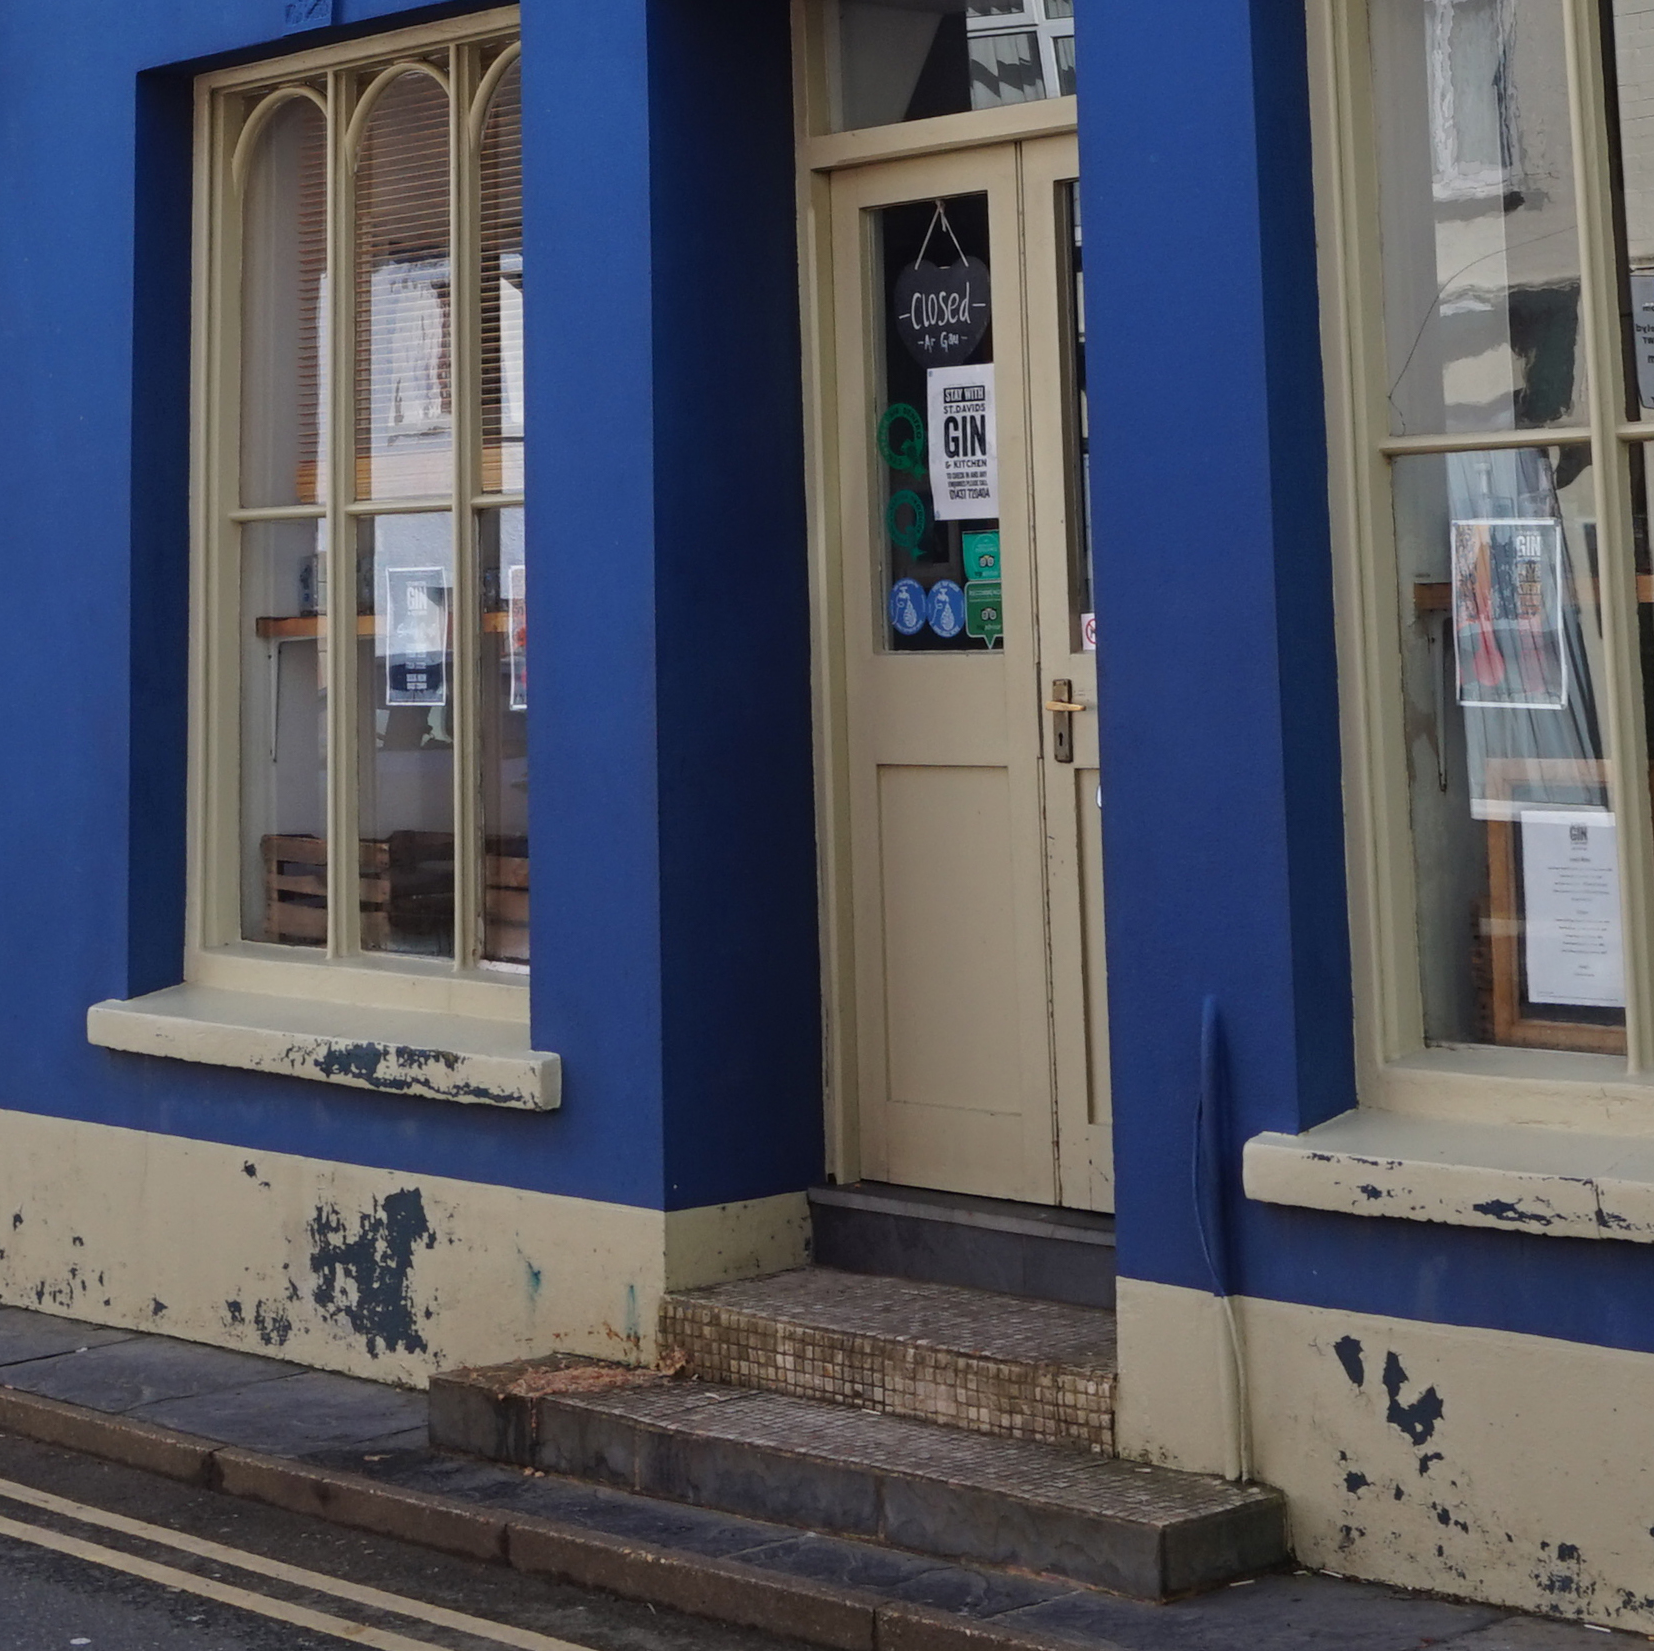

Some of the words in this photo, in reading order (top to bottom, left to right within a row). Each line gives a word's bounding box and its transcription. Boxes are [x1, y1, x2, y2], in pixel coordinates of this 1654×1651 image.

[945, 388, 962, 402] STAY
[964, 387, 984, 400] WITH
[944, 414, 987, 458] GIN
[945, 461, 952, 469] &
[954, 459, 987, 468] KITCHEN
[1516, 535, 1541, 557] GIN
[407, 587, 427, 609] GIN
